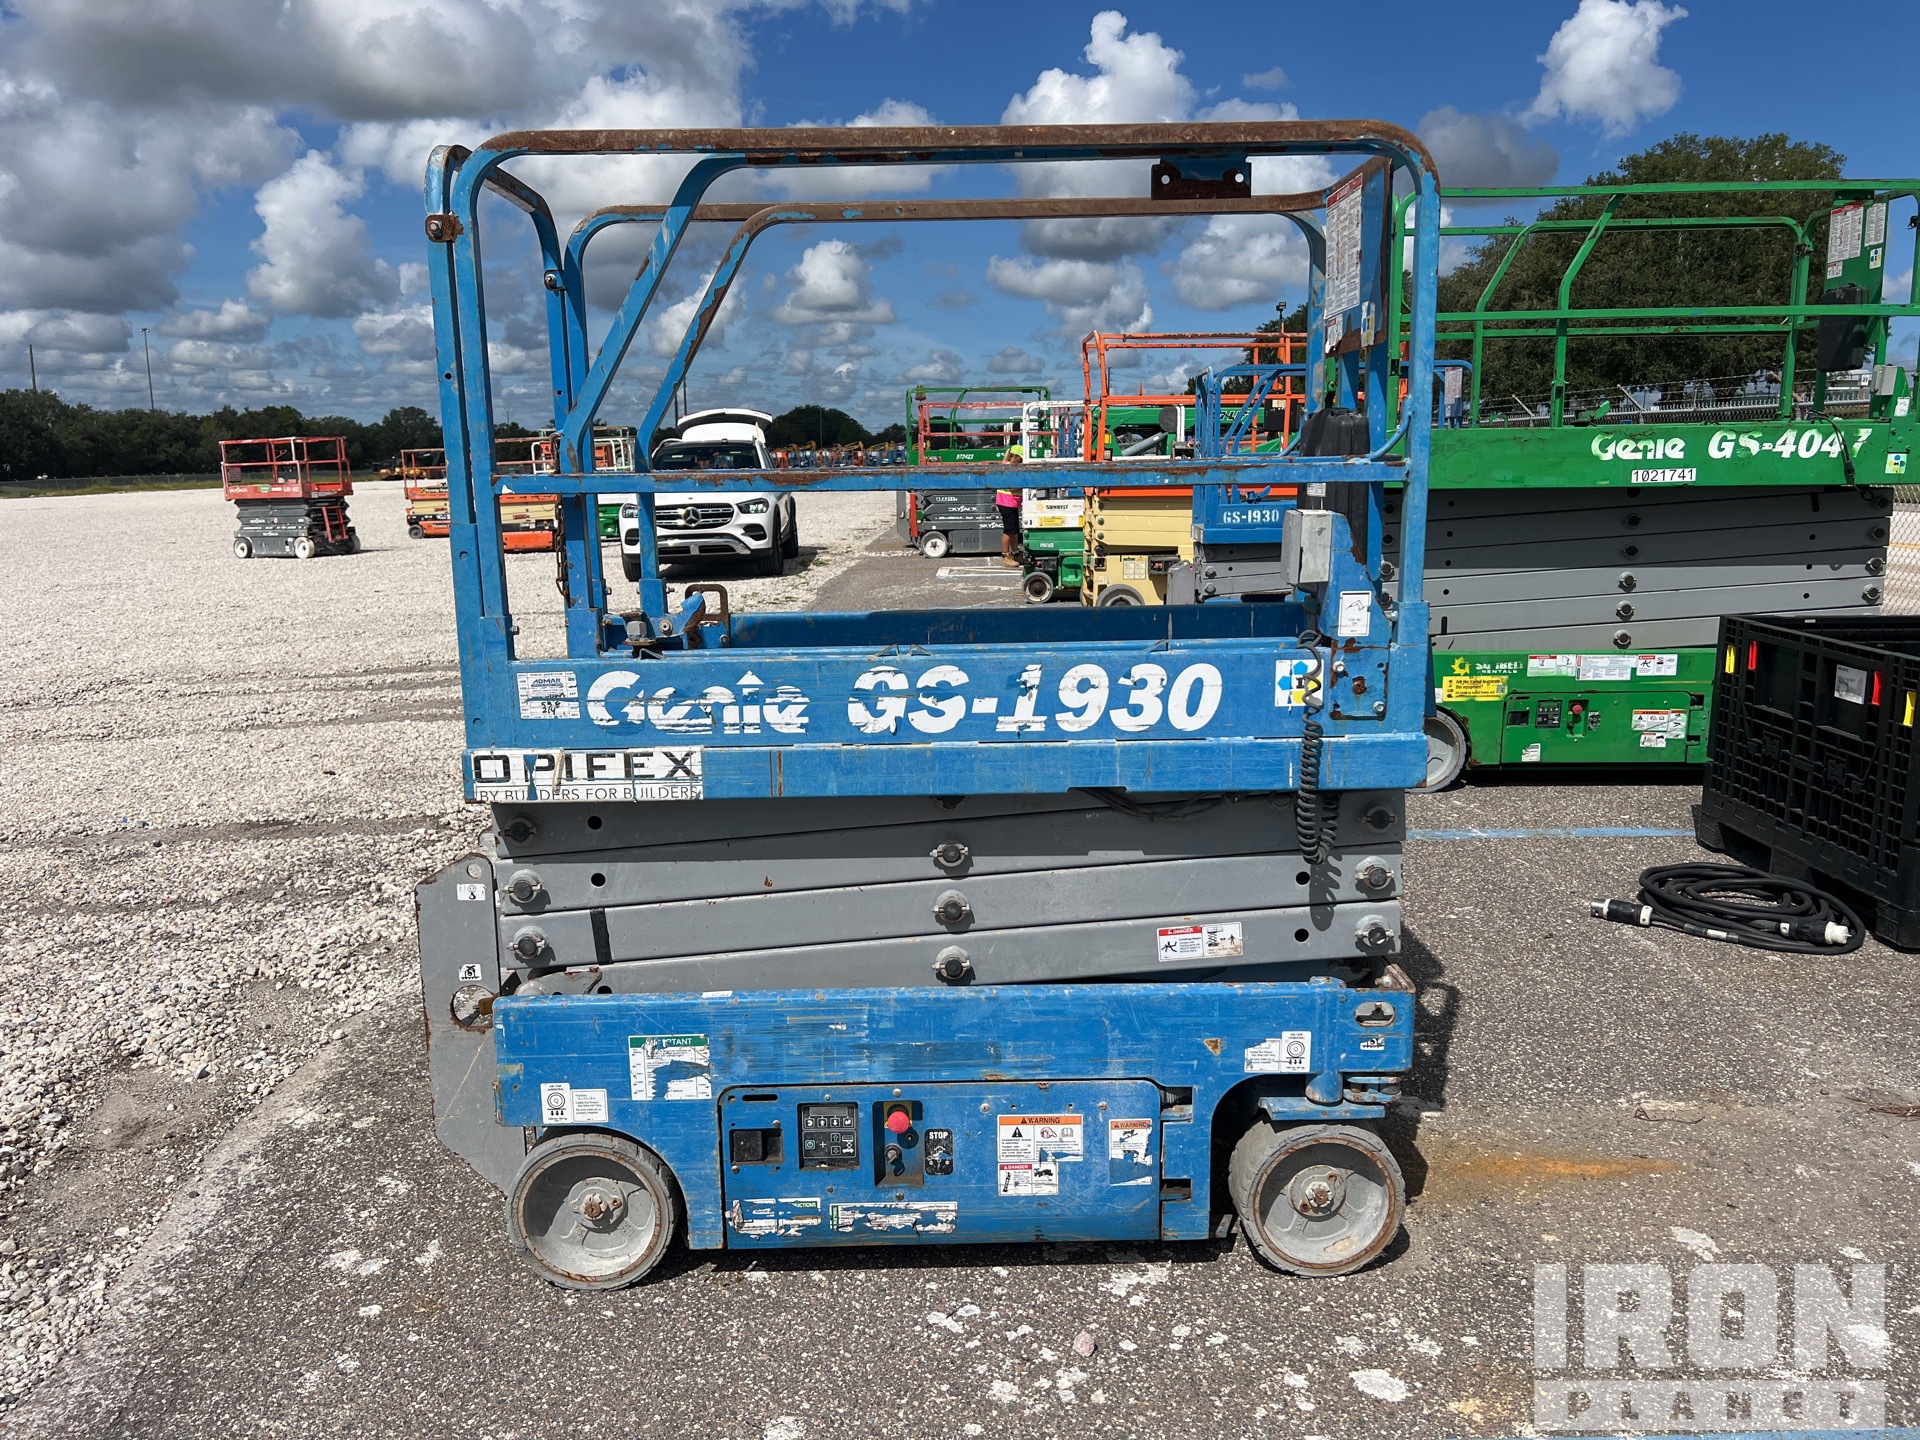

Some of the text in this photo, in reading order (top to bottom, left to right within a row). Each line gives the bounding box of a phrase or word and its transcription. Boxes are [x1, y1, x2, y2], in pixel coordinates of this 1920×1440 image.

[1591, 428, 1873, 461] Genie GS-4047
[1632, 468, 1695, 483] 1021741
[1223, 509, 1280, 524] GS-1930
[586, 662, 1222, 735] Genie GS-1930
[474, 751, 699, 783] OPIFEX
[480, 791, 499, 801] BY
[586, 788, 617, 800] FOR
[623, 785, 699, 799] BUILDERS
[929, 1131, 948, 1140] STOP
